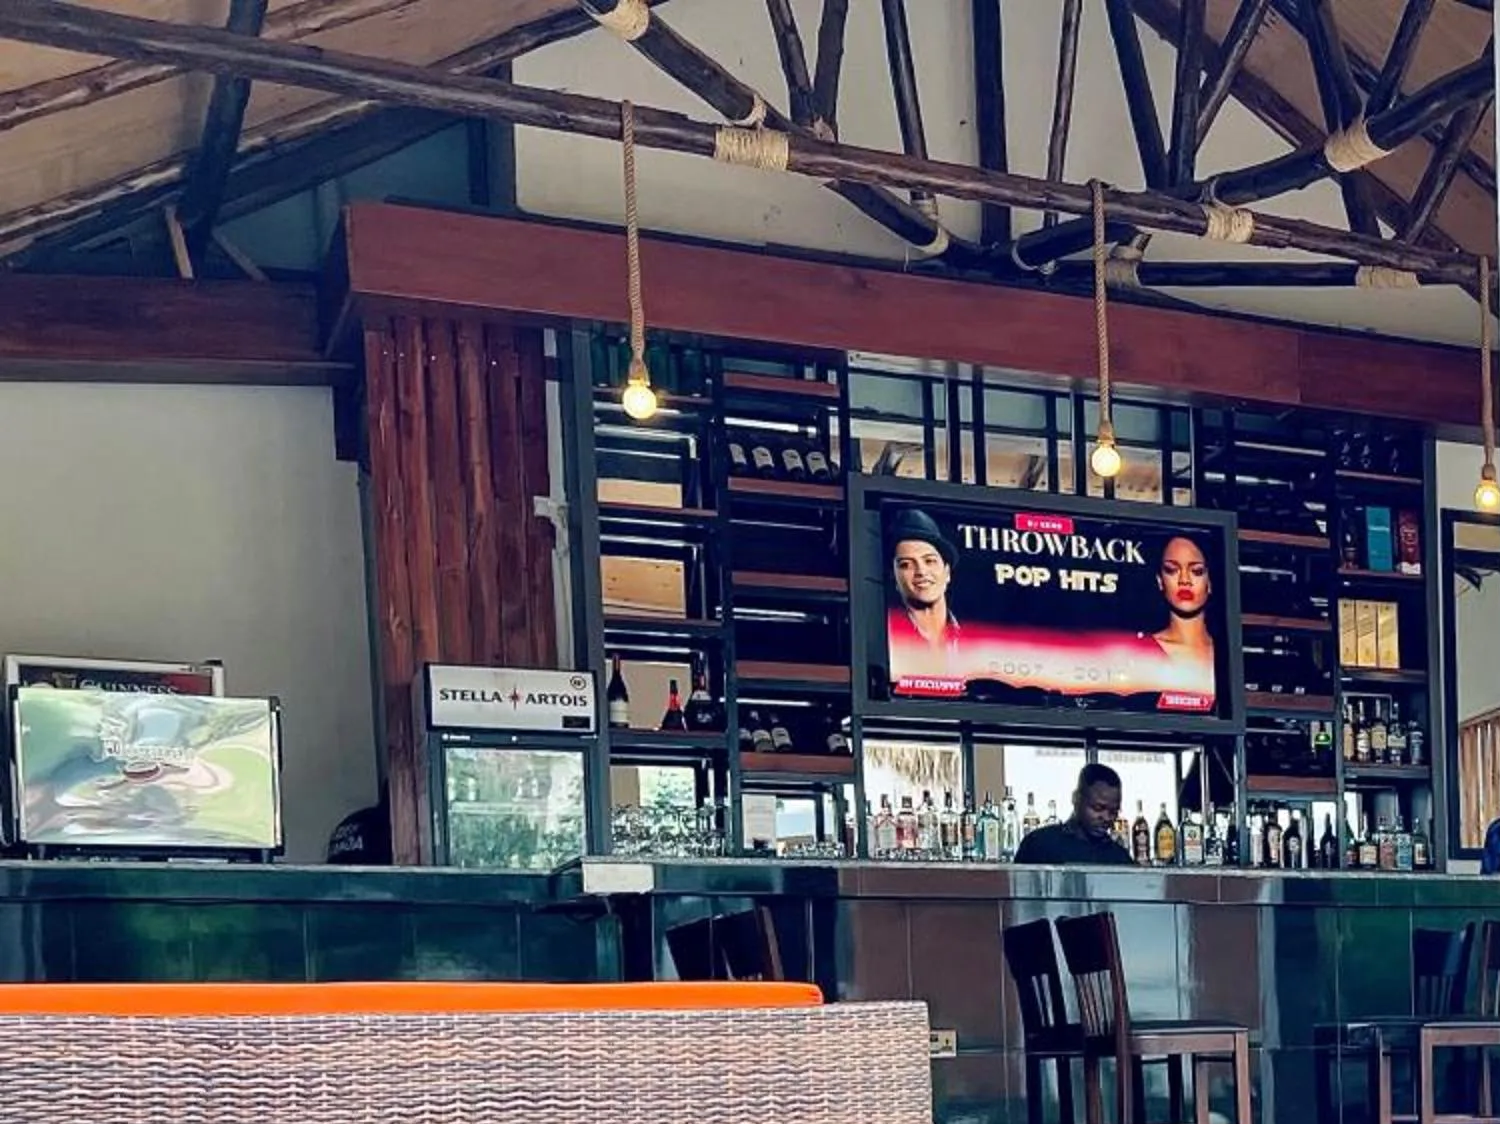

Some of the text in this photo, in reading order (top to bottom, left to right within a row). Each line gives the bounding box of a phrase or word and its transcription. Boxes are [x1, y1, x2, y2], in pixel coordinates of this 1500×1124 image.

[956, 523, 1146, 565] THROWBACK
[994, 563, 1119, 593] POP HITS
[439, 687, 588, 707] STELLA ARTOIS
